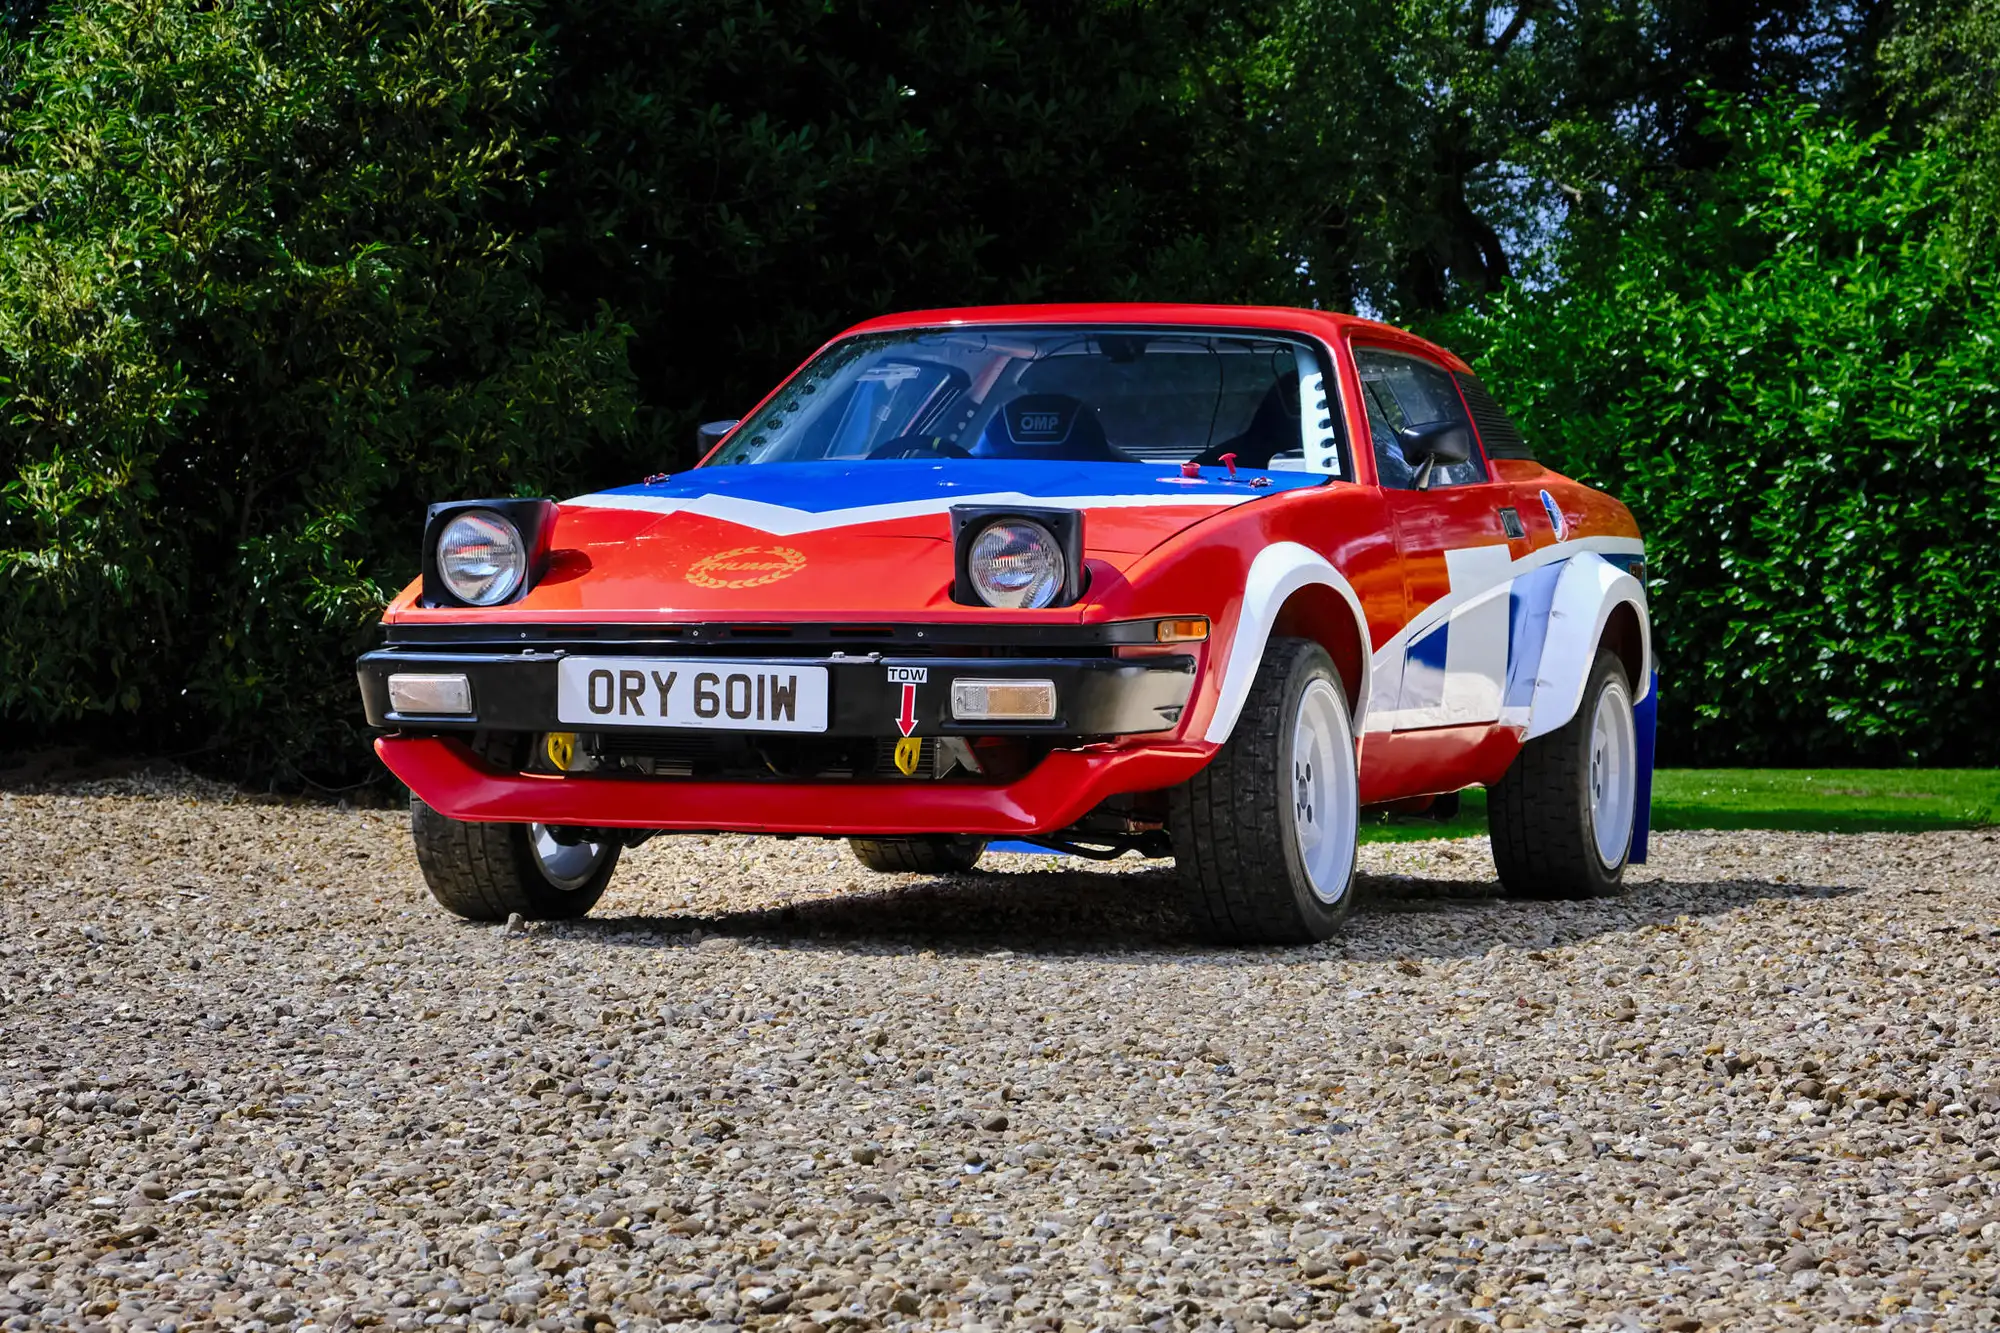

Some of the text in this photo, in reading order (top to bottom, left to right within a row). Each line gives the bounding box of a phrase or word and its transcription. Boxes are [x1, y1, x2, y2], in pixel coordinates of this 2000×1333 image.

[1021, 416, 1058, 430] OMP
[689, 562, 807, 572] TRIUMPH
[889, 669, 925, 680] TOW
[588, 669, 797, 722] ORY 601W
